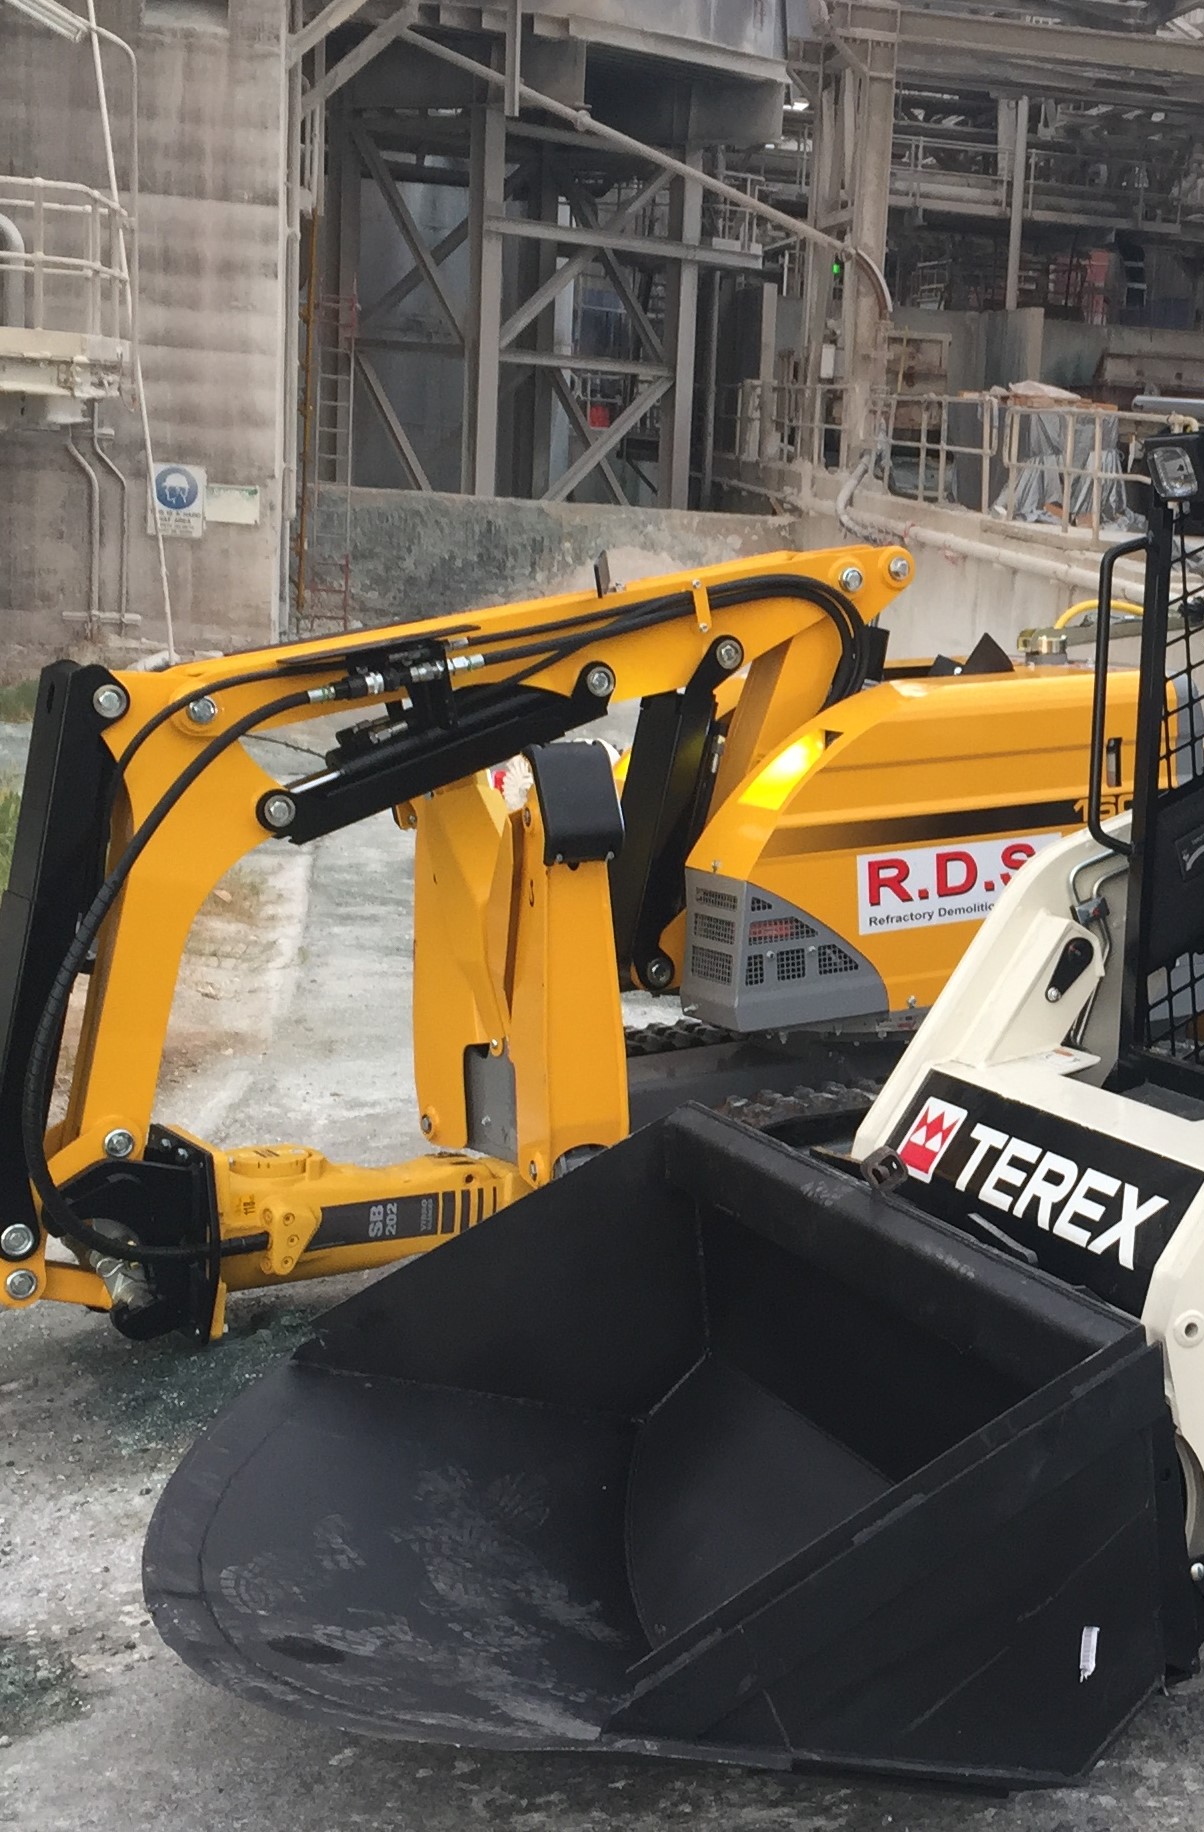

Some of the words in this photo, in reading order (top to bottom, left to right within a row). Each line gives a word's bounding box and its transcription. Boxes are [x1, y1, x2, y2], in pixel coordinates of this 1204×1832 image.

[868, 910, 935, 927] Refractory
[955, 1122, 1170, 1271] TEREX
[368, 1204, 384, 1238] SB
[385, 1202, 398, 1236] 202
